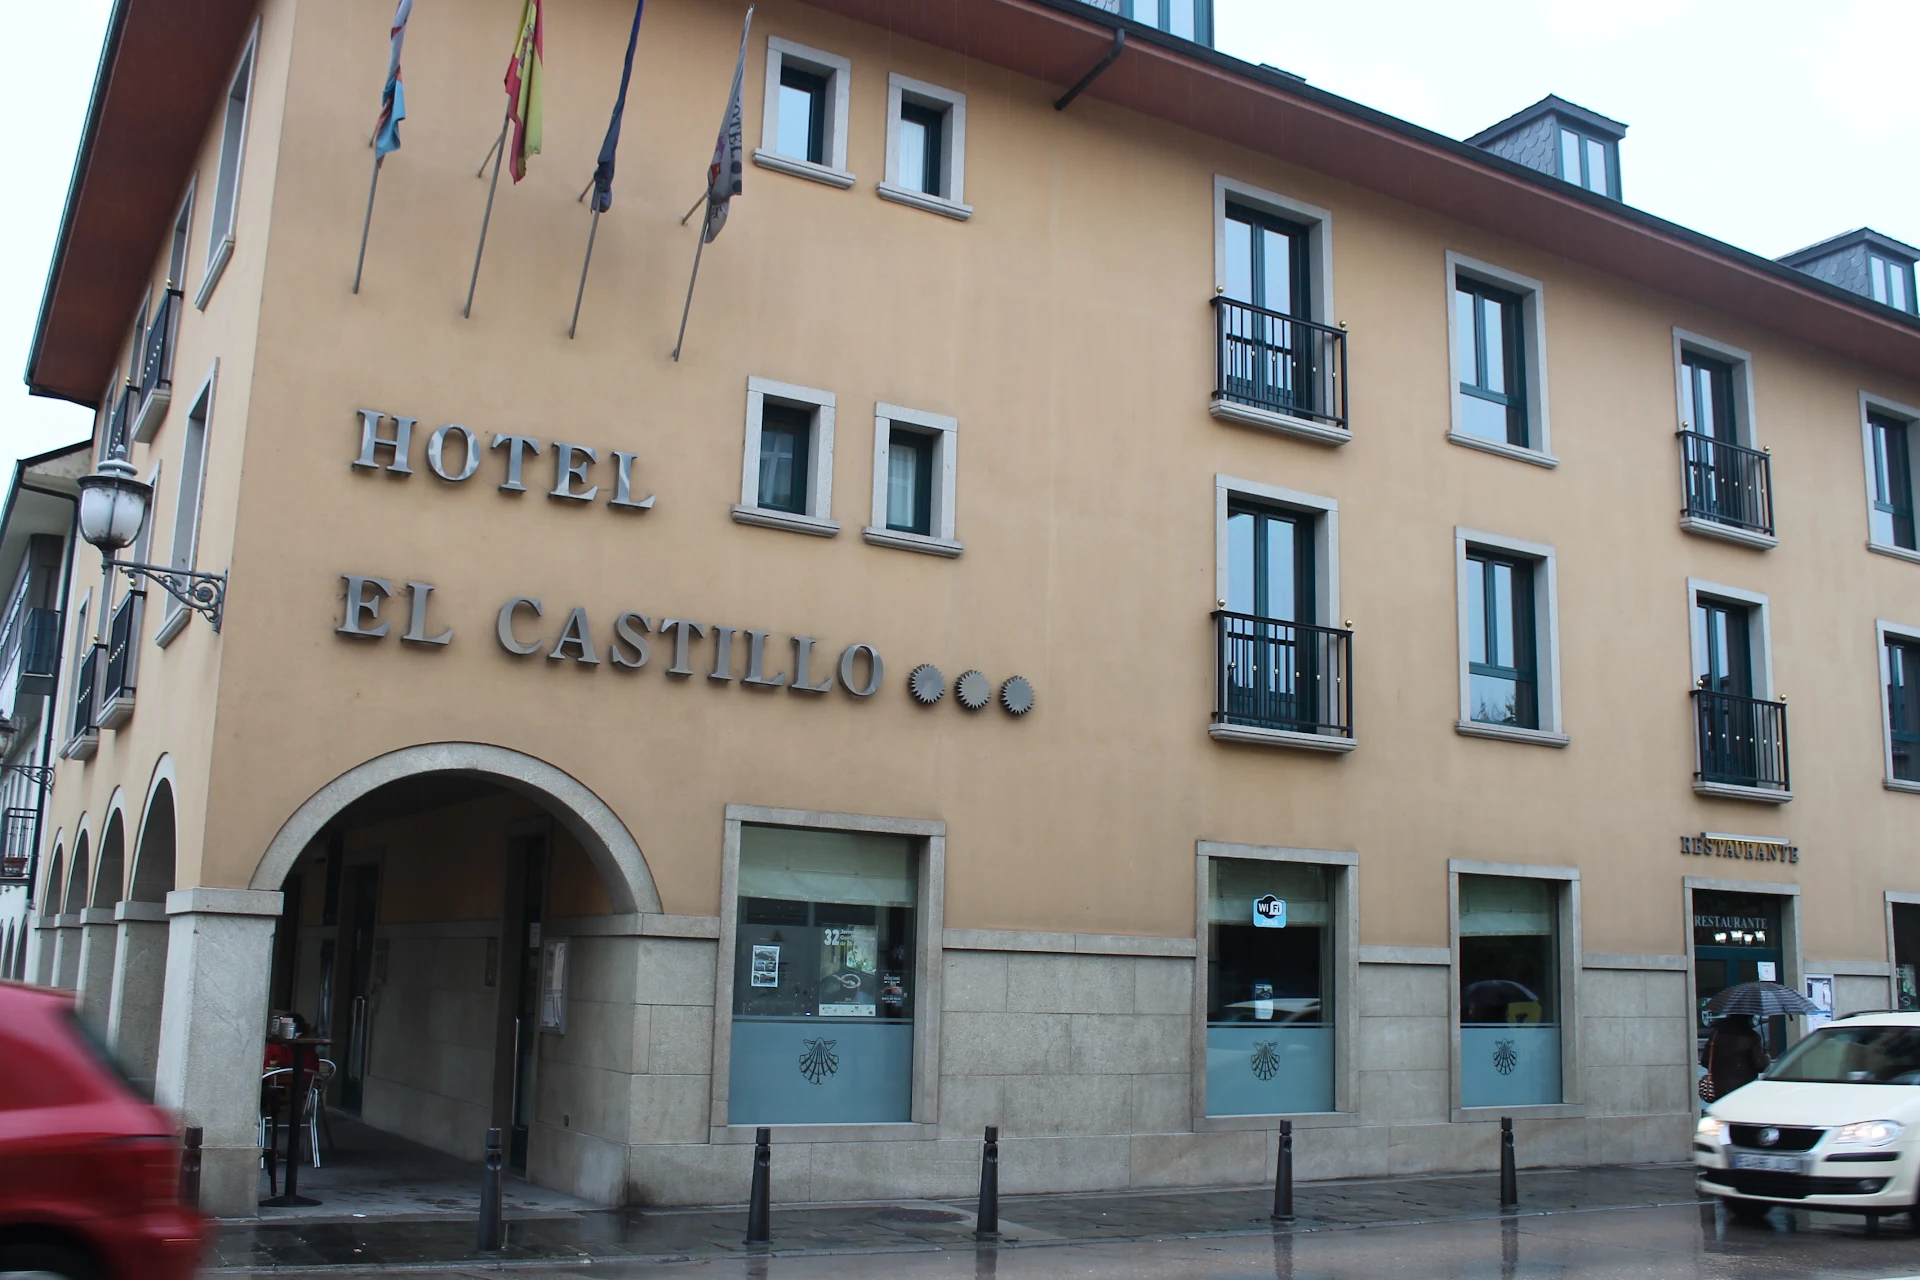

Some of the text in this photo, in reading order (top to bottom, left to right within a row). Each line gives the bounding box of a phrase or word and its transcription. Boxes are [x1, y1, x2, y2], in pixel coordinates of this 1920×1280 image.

[352, 409, 656, 510] HOTEL
[335, 574, 885, 697] EL CASTILLO
[1680, 836, 1799, 863] RESTAURANTE
[1694, 916, 1768, 930] RESTAURANTE
[824, 928, 840, 946] 32
